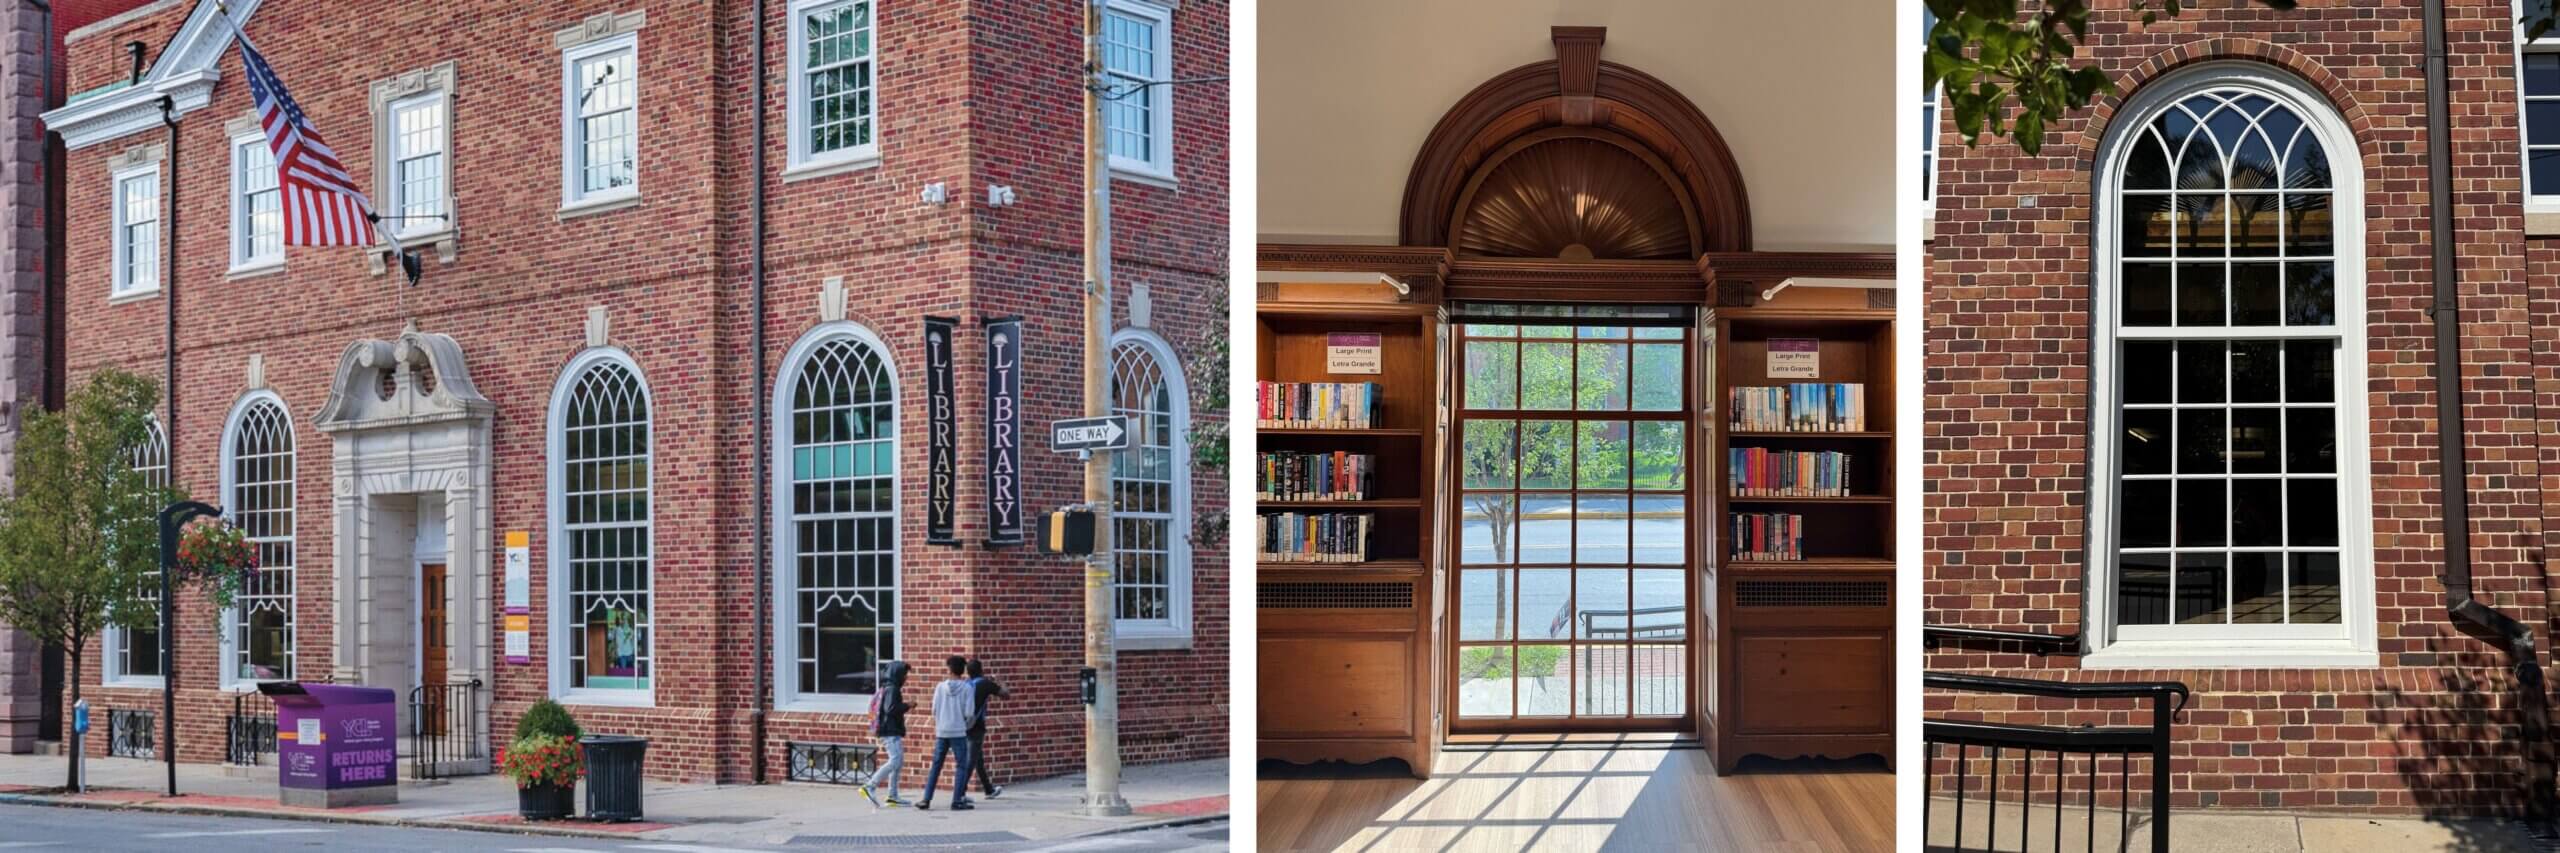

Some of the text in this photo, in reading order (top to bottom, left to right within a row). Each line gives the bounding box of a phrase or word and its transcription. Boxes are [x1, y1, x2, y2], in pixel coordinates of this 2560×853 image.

[931, 342, 950, 525] LIBRARY
[993, 344, 1015, 526] LIBRARY
[1059, 427, 1110, 441] ONE WAY
[332, 750, 393, 766] RETURNS
[340, 765, 386, 782] HERE
